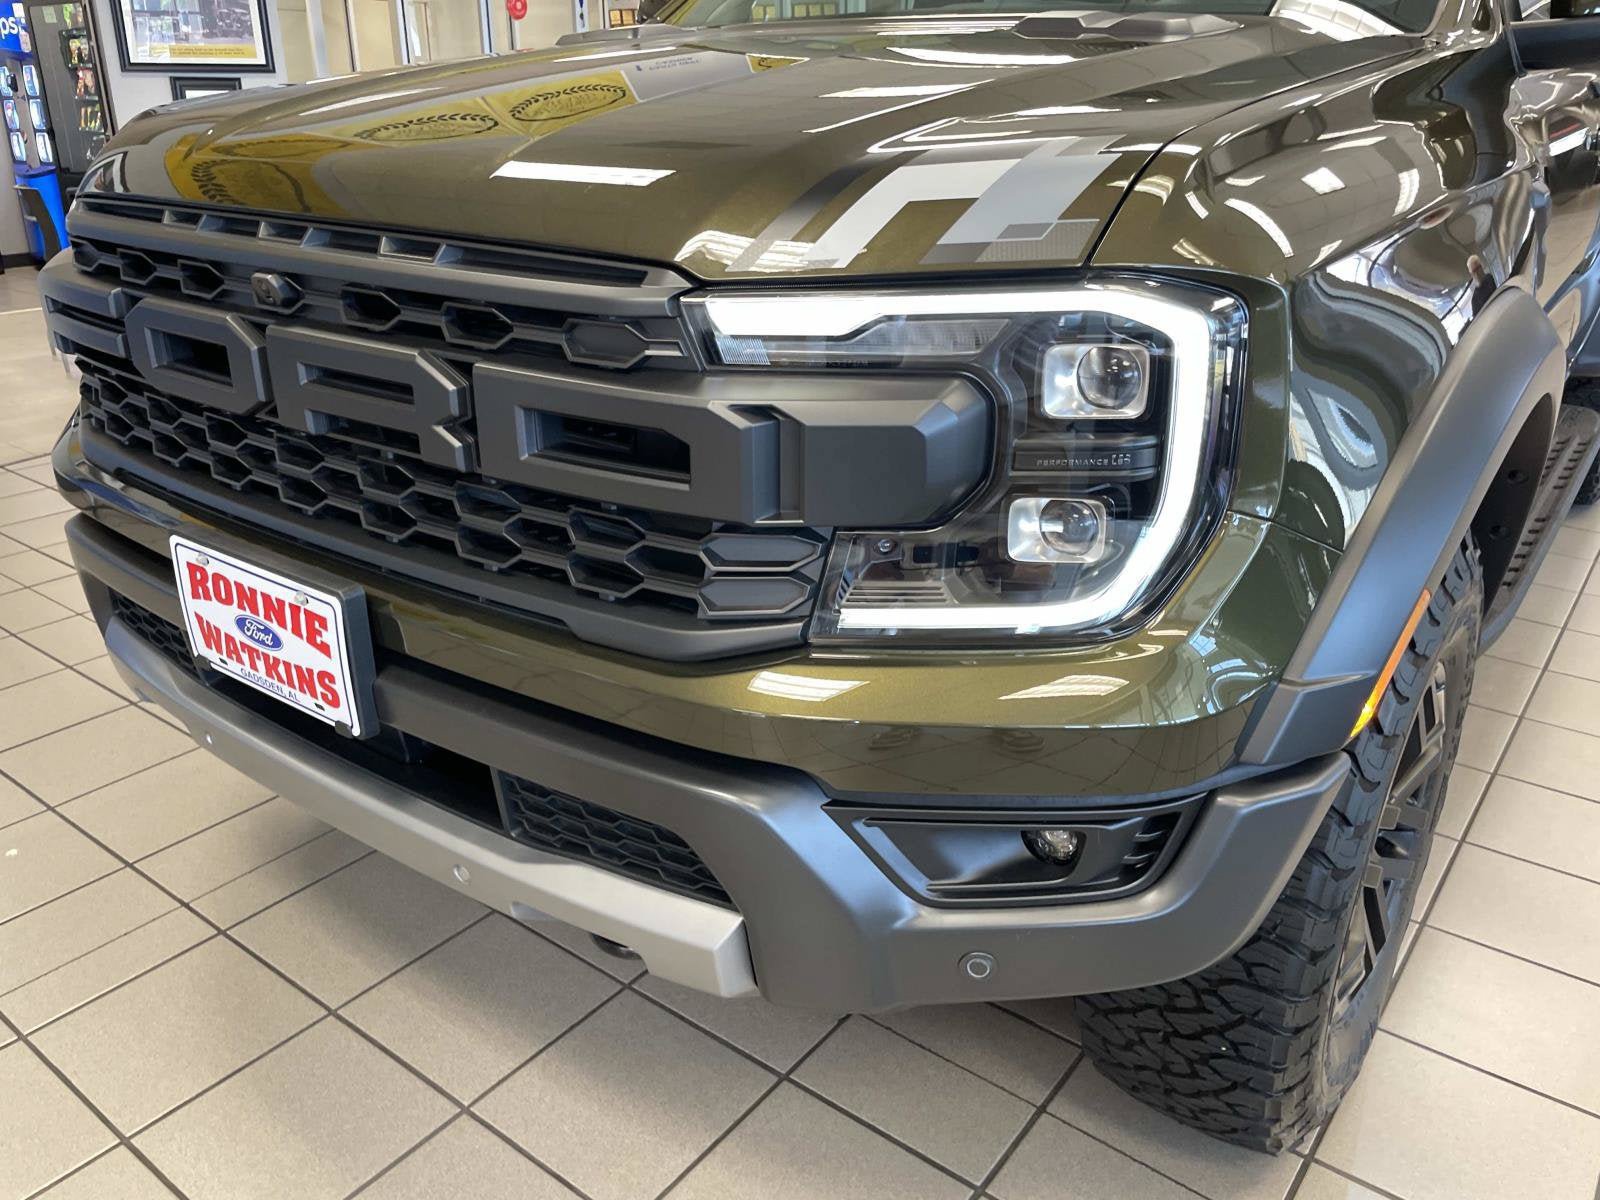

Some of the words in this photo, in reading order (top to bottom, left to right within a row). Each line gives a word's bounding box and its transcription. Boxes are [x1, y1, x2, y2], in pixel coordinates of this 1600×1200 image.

[1036, 457, 1109, 467] PERFORMANCE
[186, 561, 332, 660] RONNIE
[244, 619, 274, 647] Ford
[194, 611, 341, 709] WATKINS
[240, 667, 286, 698] GADSDEN,
[288, 690, 301, 703] AL
